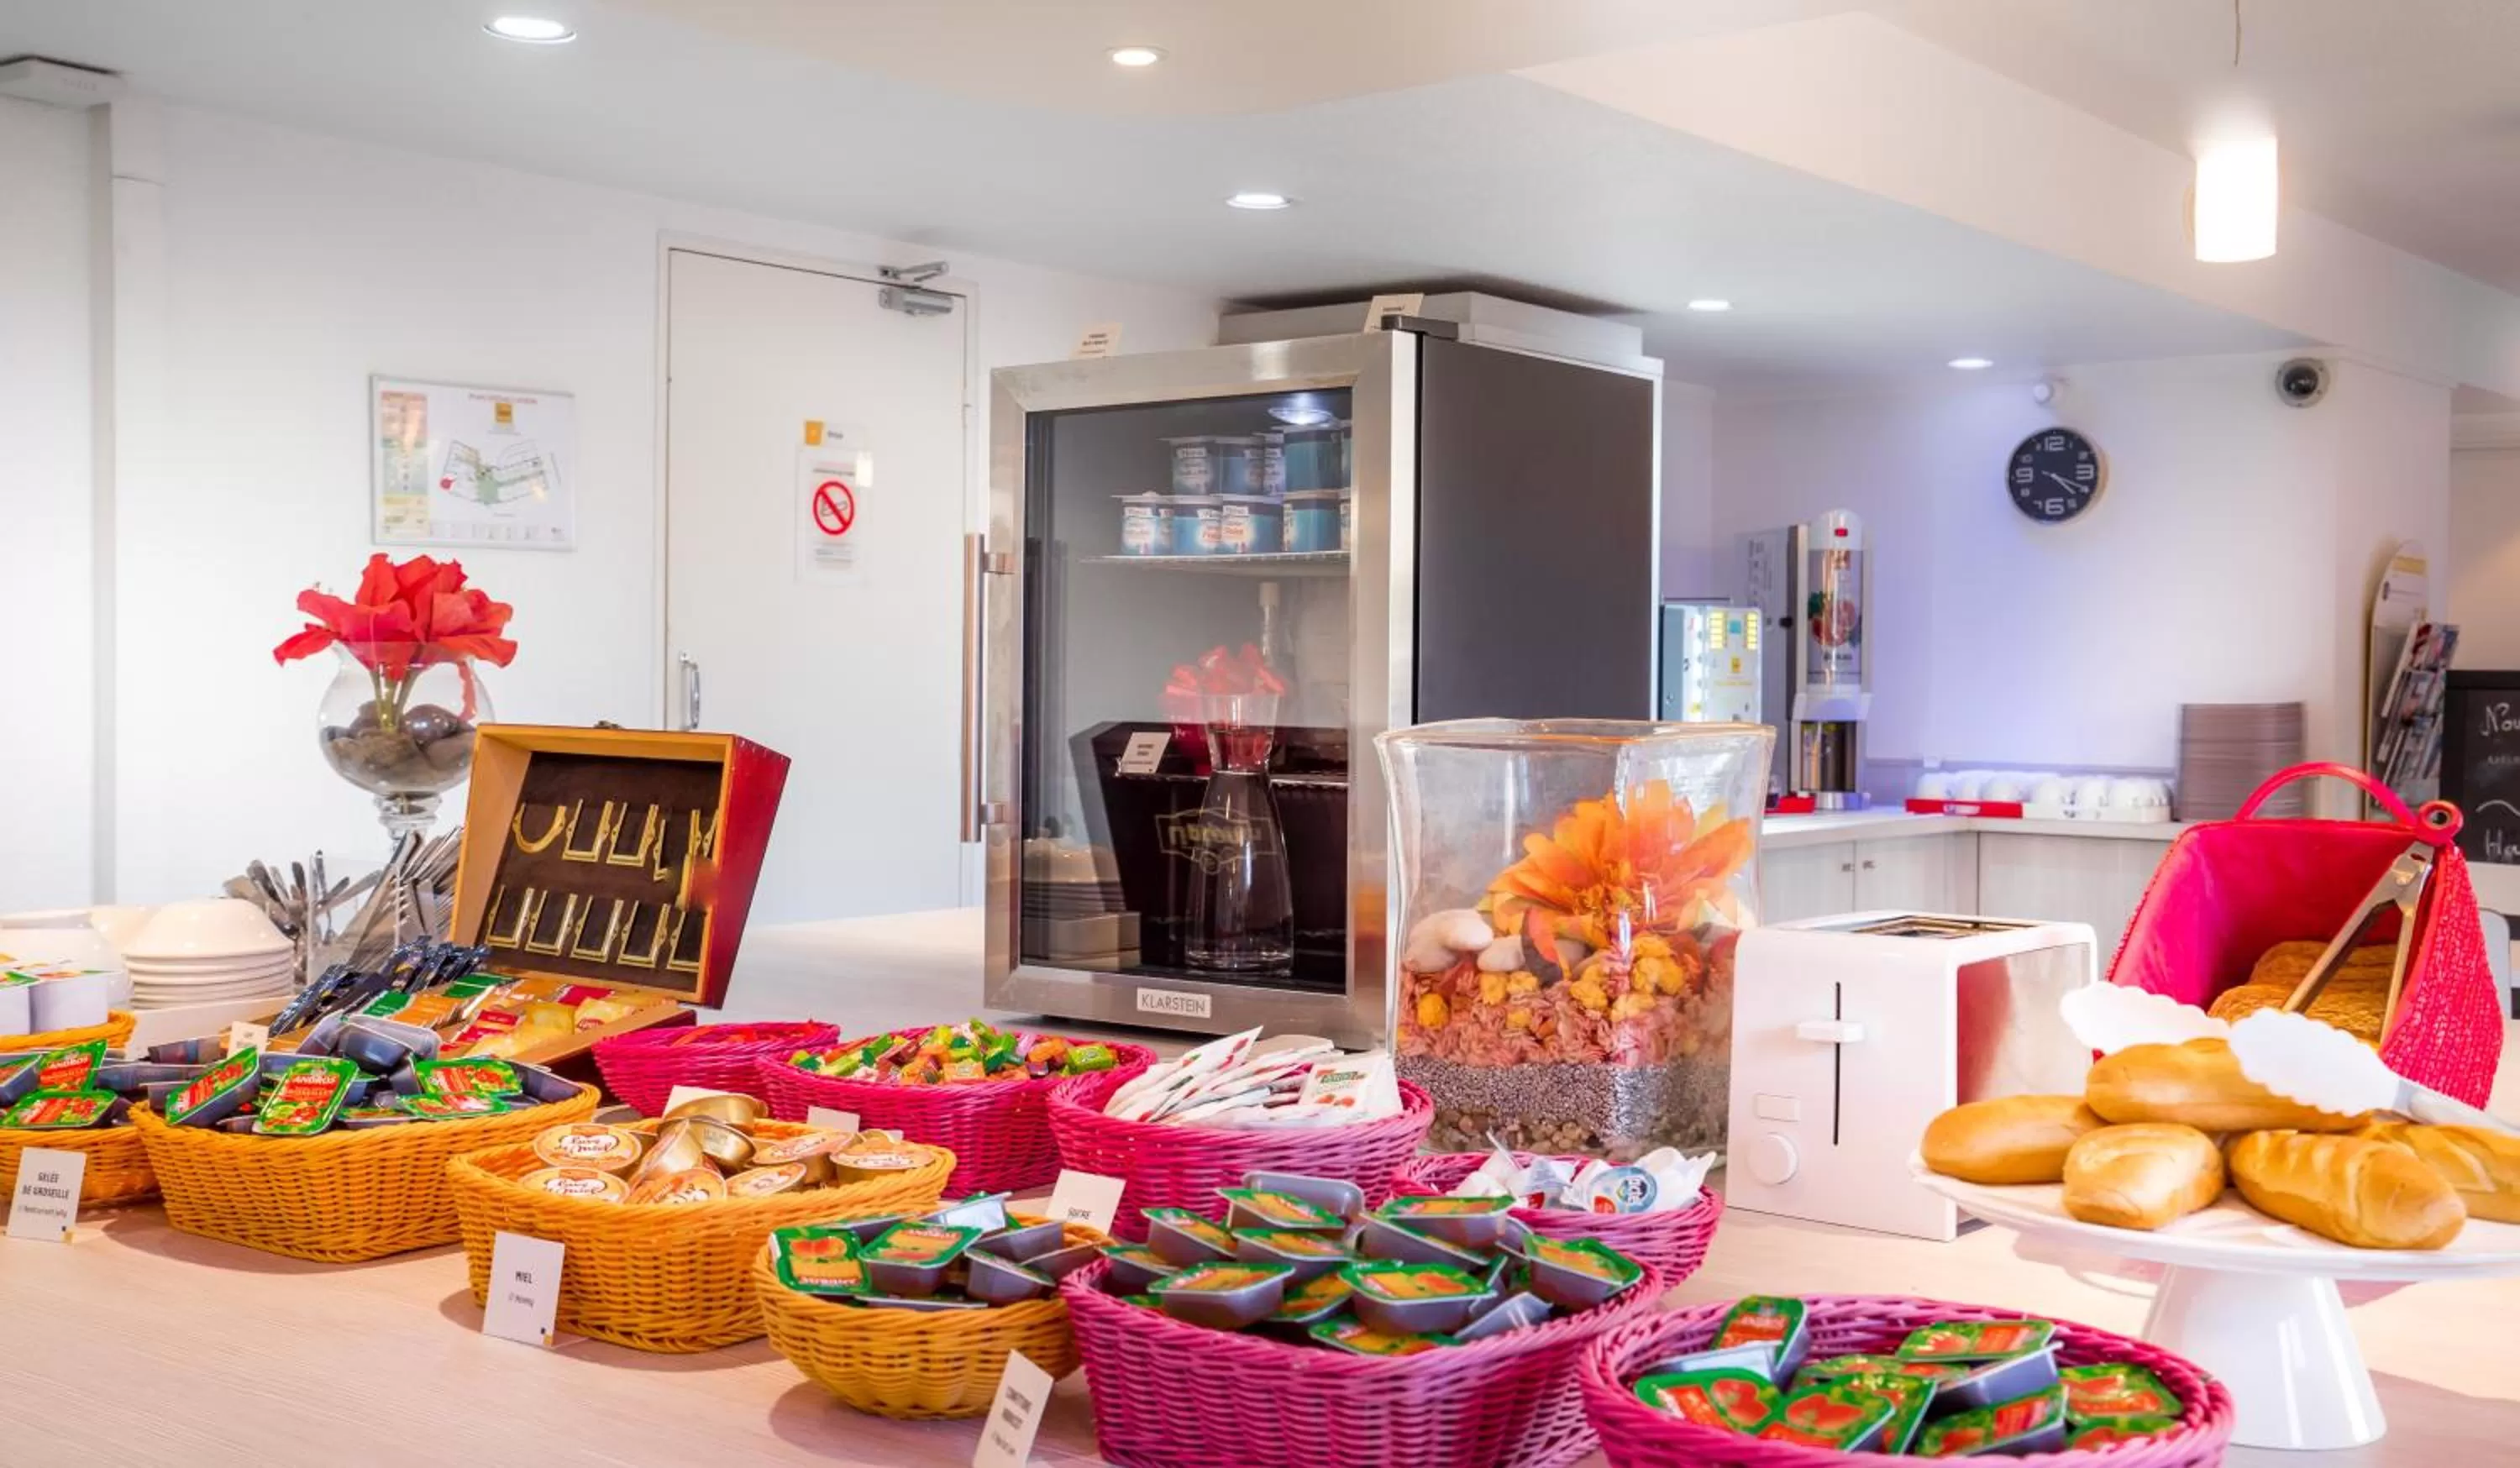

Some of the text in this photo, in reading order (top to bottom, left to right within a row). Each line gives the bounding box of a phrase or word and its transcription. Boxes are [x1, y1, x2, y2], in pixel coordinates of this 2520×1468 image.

[2044, 435, 2066, 452] 12
[2015, 467, 2034, 484] 9
[2075, 463, 2095, 481] 3
[2045, 497, 2065, 516] 6
[1142, 994, 1205, 1014] KLARSTEIN
[292, 1075, 338, 1084] ANDROS
[515, 1271, 533, 1284] MIEL
